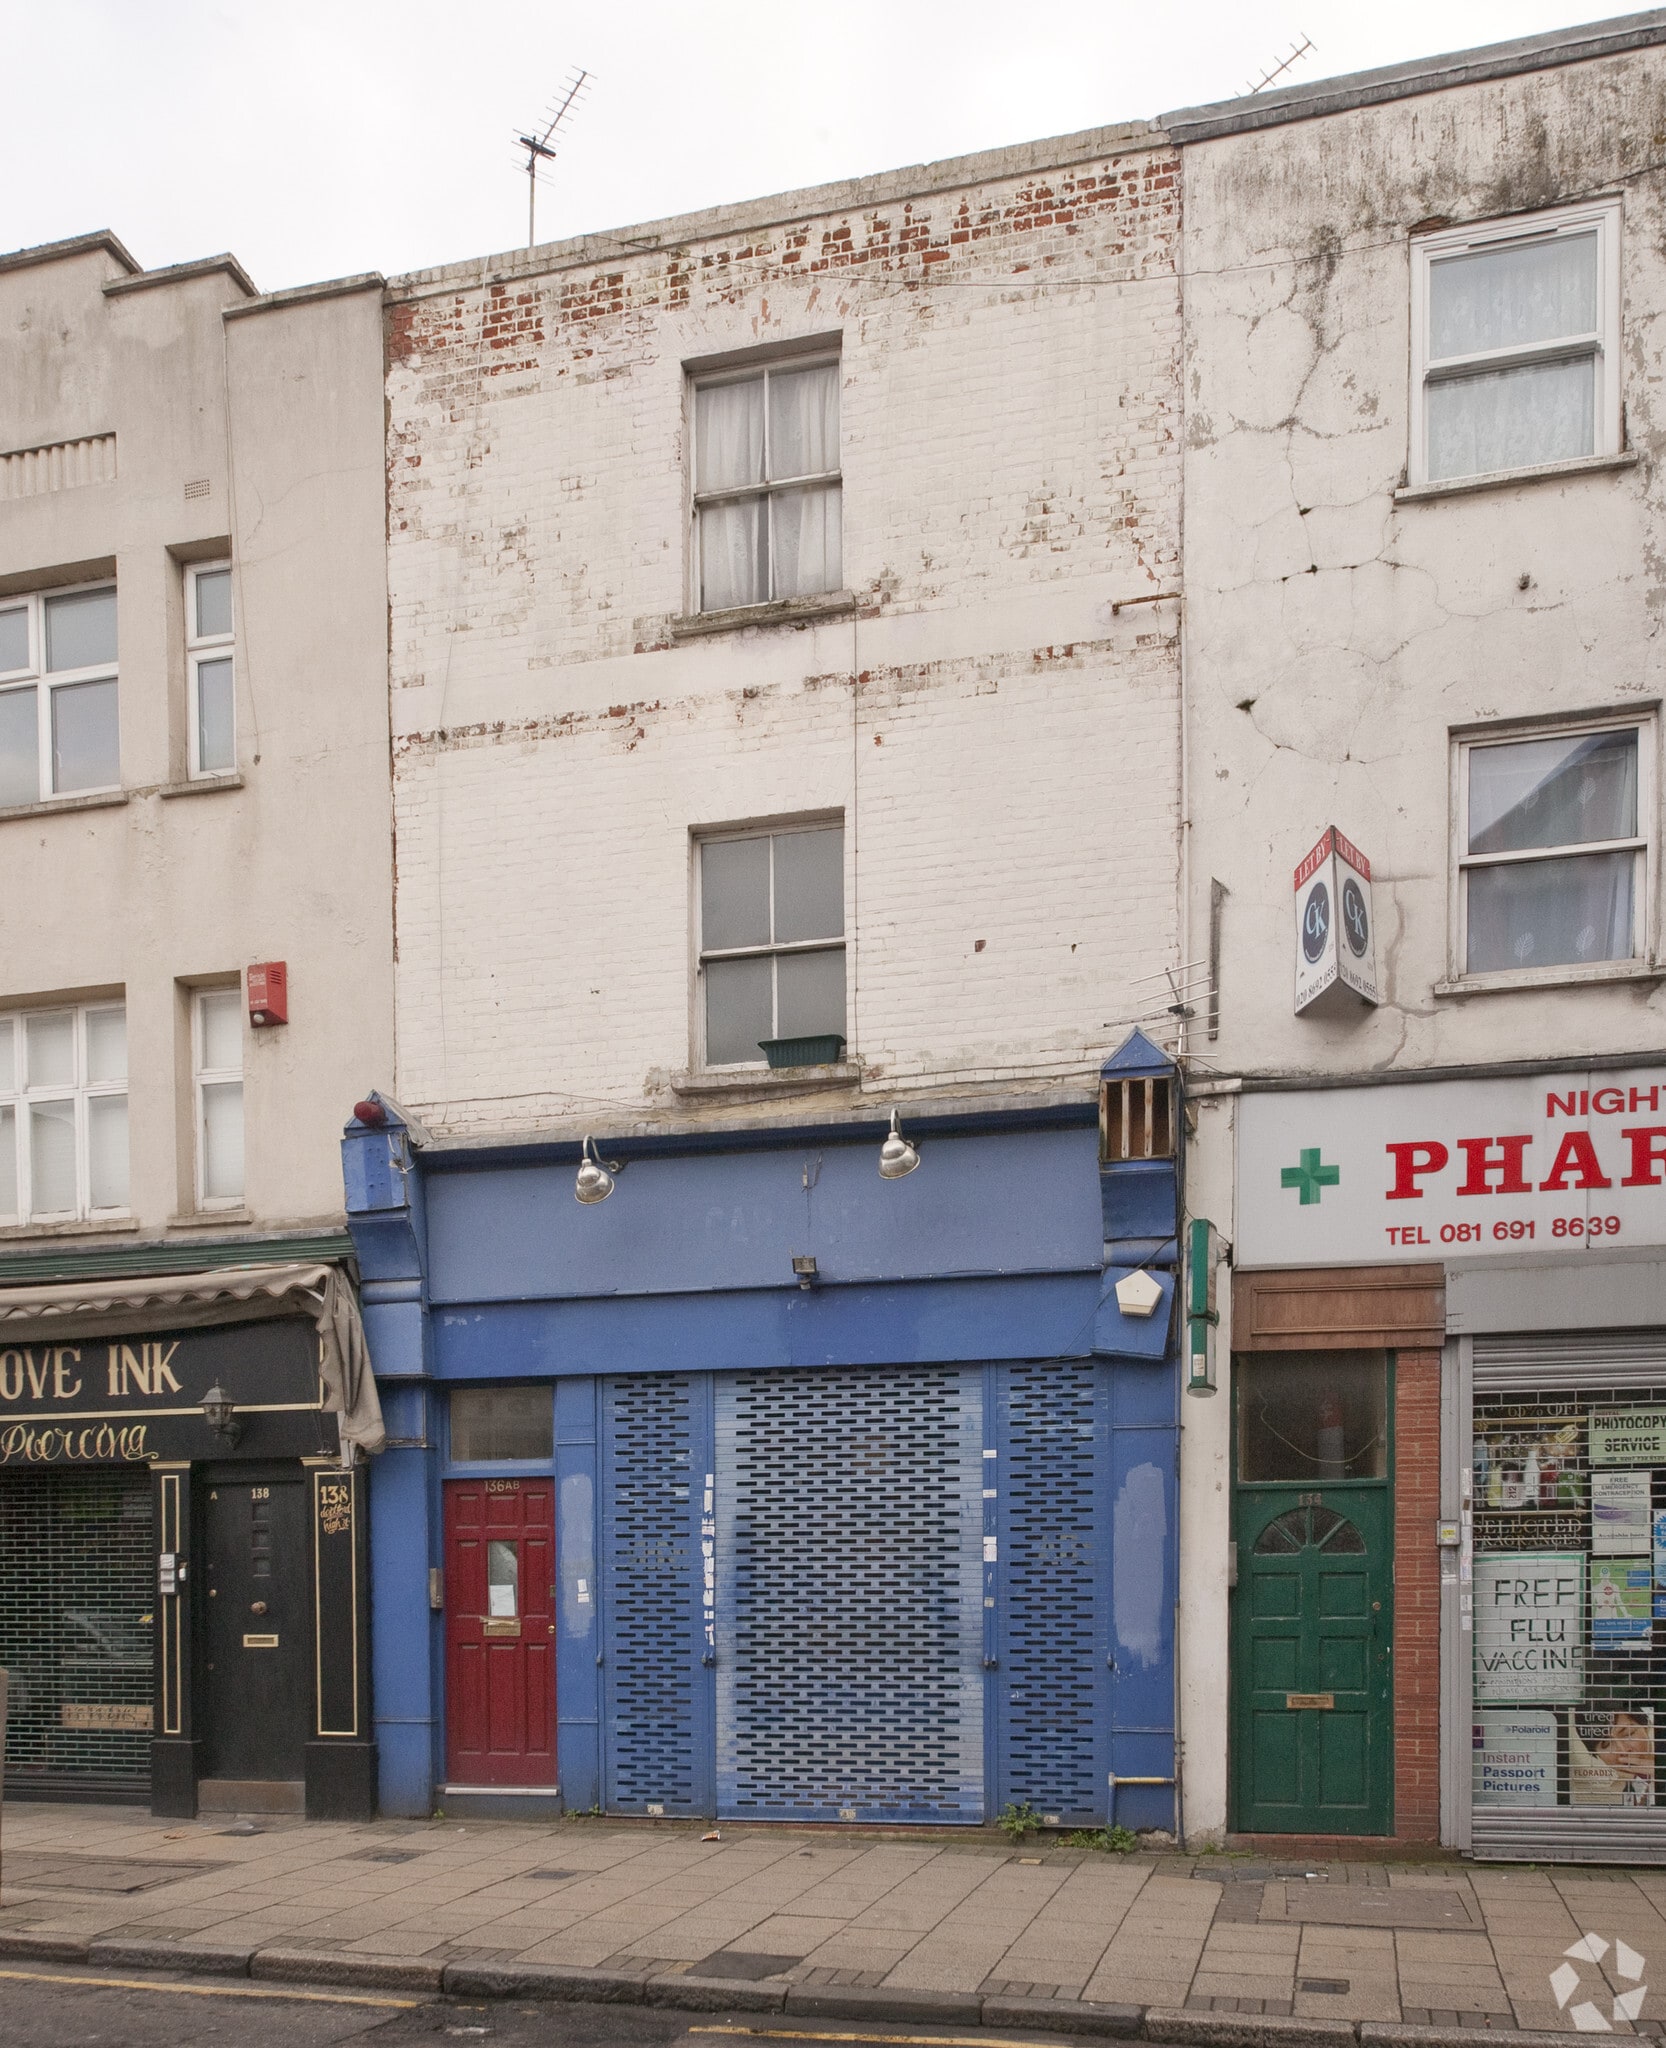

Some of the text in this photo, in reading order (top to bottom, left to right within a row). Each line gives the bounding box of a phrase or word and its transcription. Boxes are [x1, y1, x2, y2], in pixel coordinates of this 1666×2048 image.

[1299, 838, 1328, 883] LET BY
[1355, 850, 1366, 873] BY
[1306, 900, 1326, 939] CK
[1546, 1085, 1666, 1118] NIGH
[1386, 1215, 1621, 1245] TEL 081 691 8639
[0, 1341, 184, 1400] OVE INK
[1547, 1402, 1583, 1416] OFF
[1594, 1415, 1666, 1429] PHOTOCOPY
[0, 1422, 159, 1464] Piercing
[1604, 1437, 1660, 1452] SERVICE
[251, 1488, 270, 1500] 138
[320, 1485, 349, 1504] 138
[1473, 1518, 1582, 1534] SELECTED
[1511, 1619, 1565, 1642] FLU
[1480, 1646, 1582, 1671] VACCINE
[1583, 1712, 1615, 1722] tired
[1511, 1725, 1550, 1734] Polaroid
[1483, 1752, 1531, 1764] Instant
[1483, 1766, 1546, 1779] Passport
[1573, 1769, 1614, 1777] FLORADIX
[1483, 1780, 1541, 1792] Pictures
